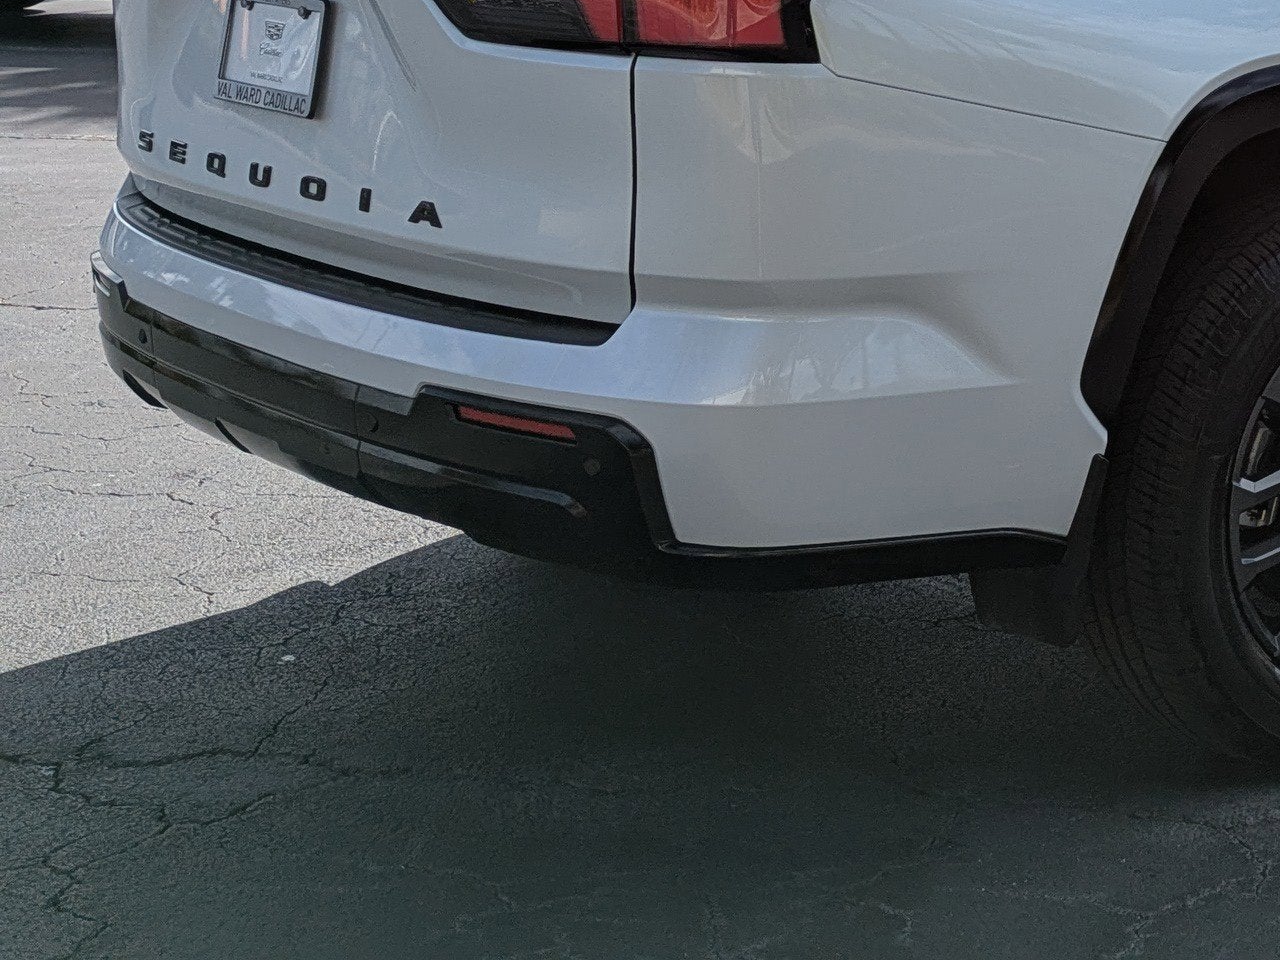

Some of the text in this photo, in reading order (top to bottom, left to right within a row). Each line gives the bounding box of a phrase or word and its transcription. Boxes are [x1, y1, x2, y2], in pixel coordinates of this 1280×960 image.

[218, 81, 307, 115] VAL WARD CADILLAC
[138, 130, 443, 229] SEQUOIA
